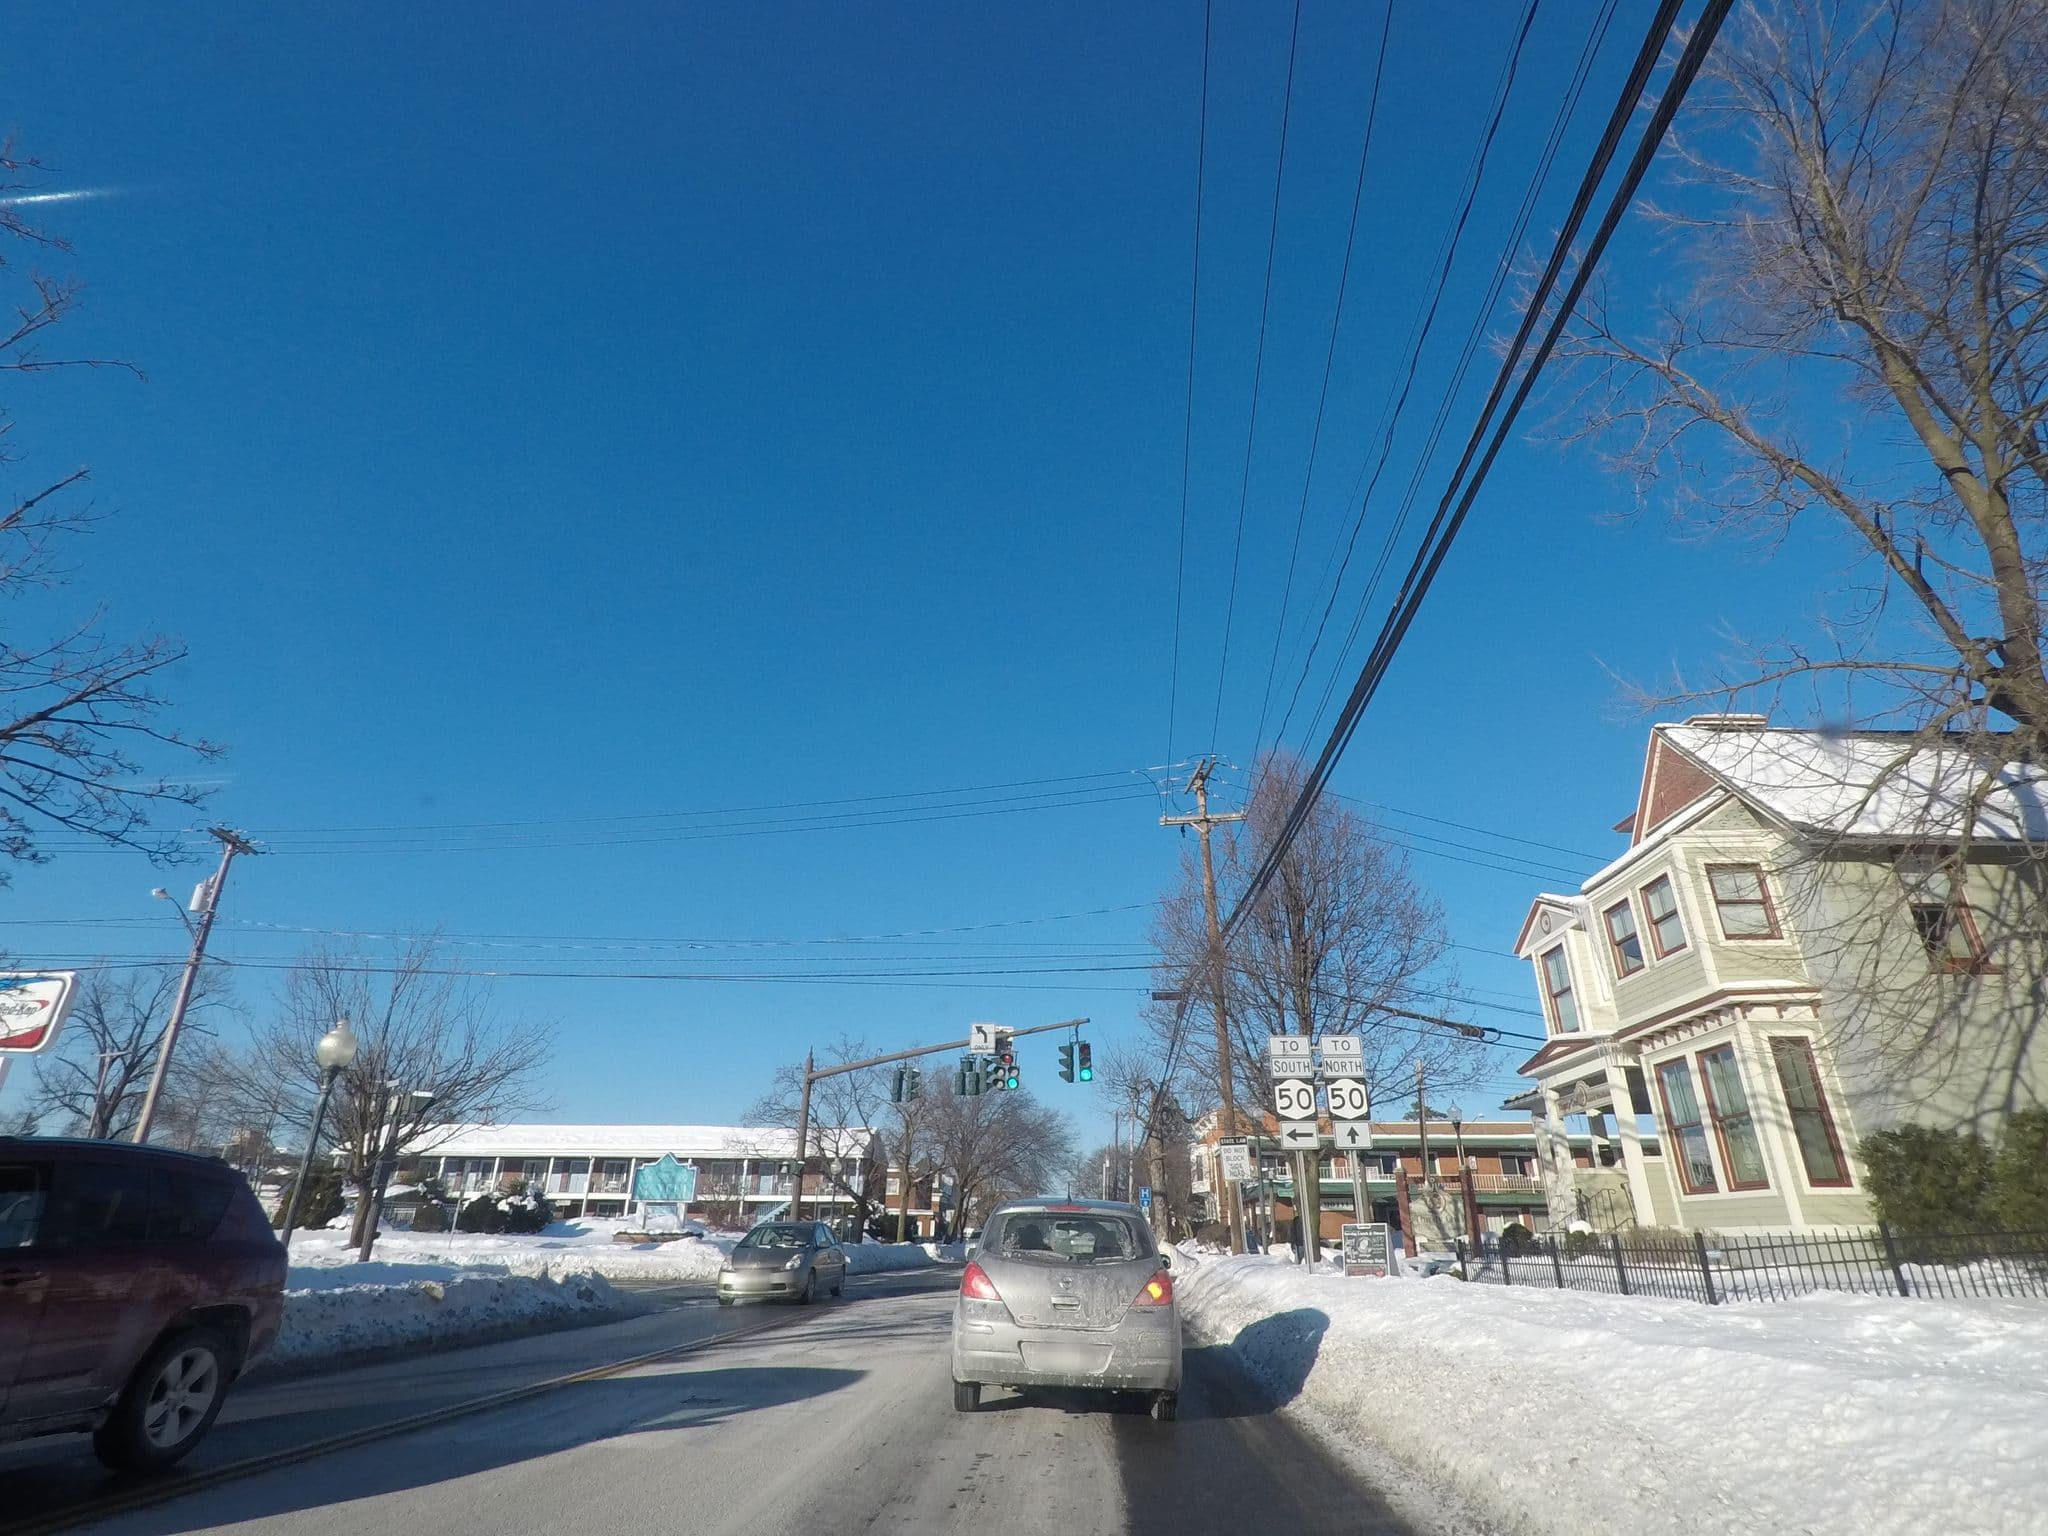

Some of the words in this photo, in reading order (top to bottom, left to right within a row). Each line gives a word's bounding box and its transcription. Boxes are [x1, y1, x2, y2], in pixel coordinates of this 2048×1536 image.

[1280, 1040, 1299, 1052] TO
[1331, 1040, 1351, 1052] TO
[1273, 1060, 1311, 1073] SOUTH
[1325, 1060, 1363, 1073] NORTH
[1278, 1087, 1313, 1111] 50
[1330, 1087, 1365, 1111] 50
[1141, 1188, 1149, 1198] H
